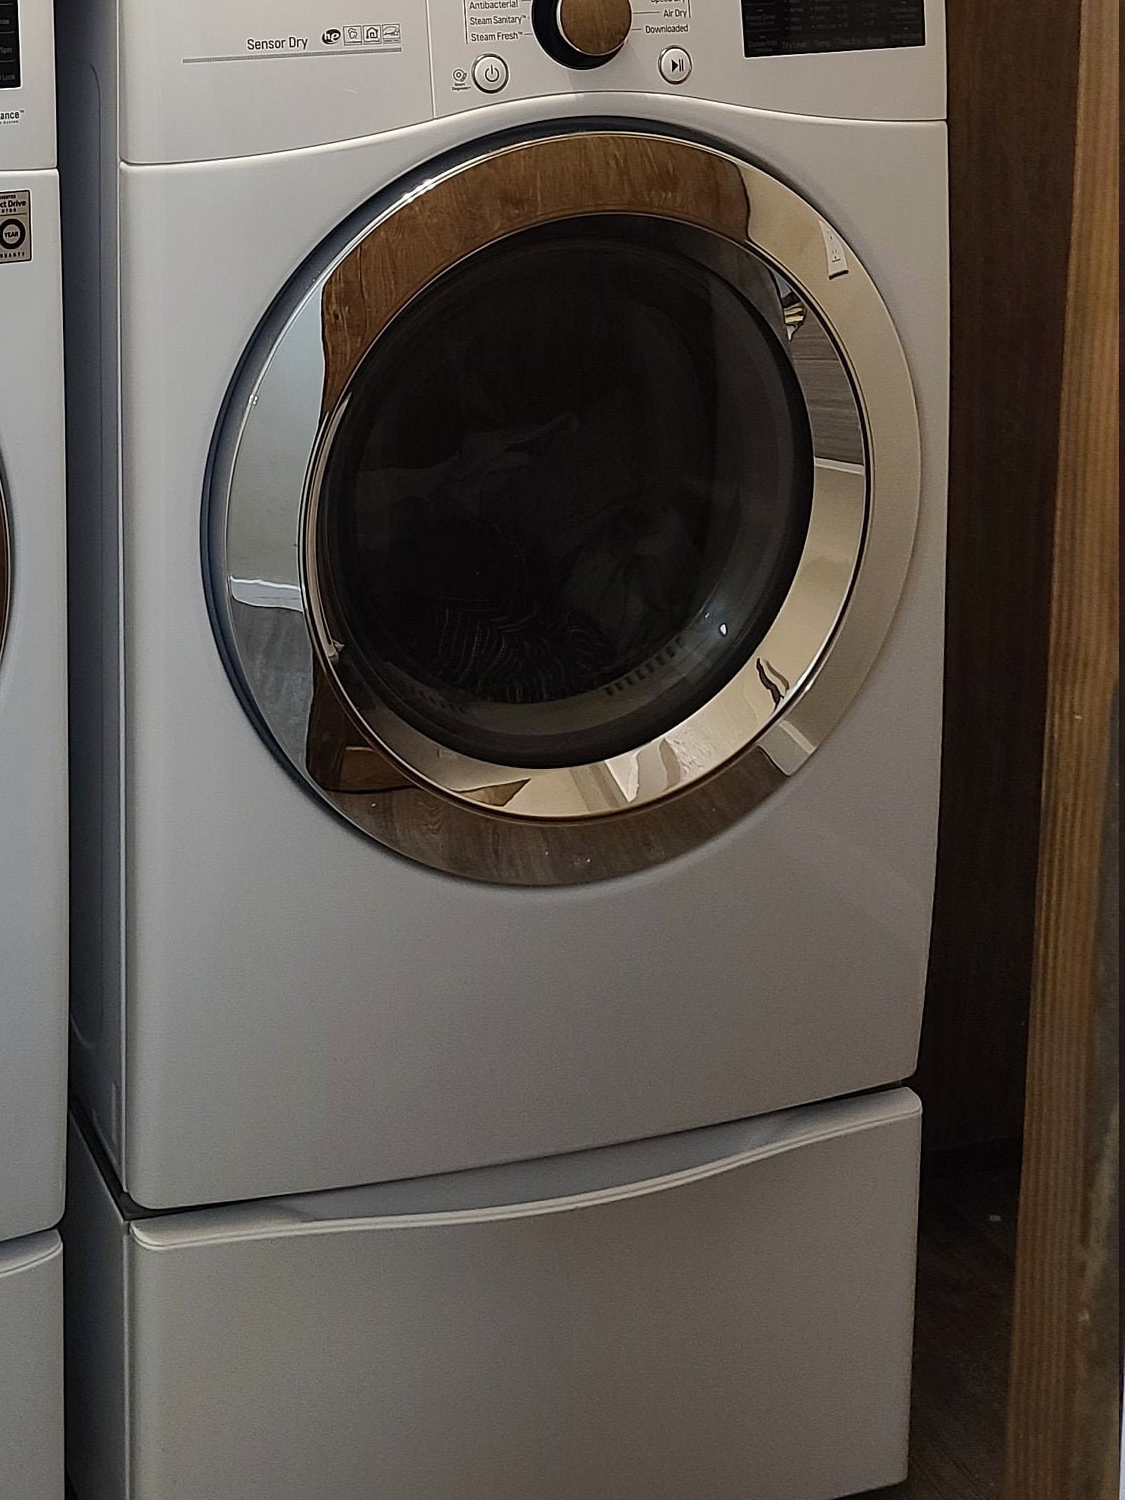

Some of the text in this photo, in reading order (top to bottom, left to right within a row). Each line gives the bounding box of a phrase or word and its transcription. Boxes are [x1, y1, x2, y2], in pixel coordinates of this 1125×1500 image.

[469, 0, 519, 10] Antibacterial
[663, 8, 687, 19] Air Dry
[470, 16, 493, 26] Steam
[645, 23, 688, 34] Downloaded
[471, 33, 497, 42] Steam
[246, 36, 308, 51] Sensor Dry
[8, 199, 27, 208] Drive
